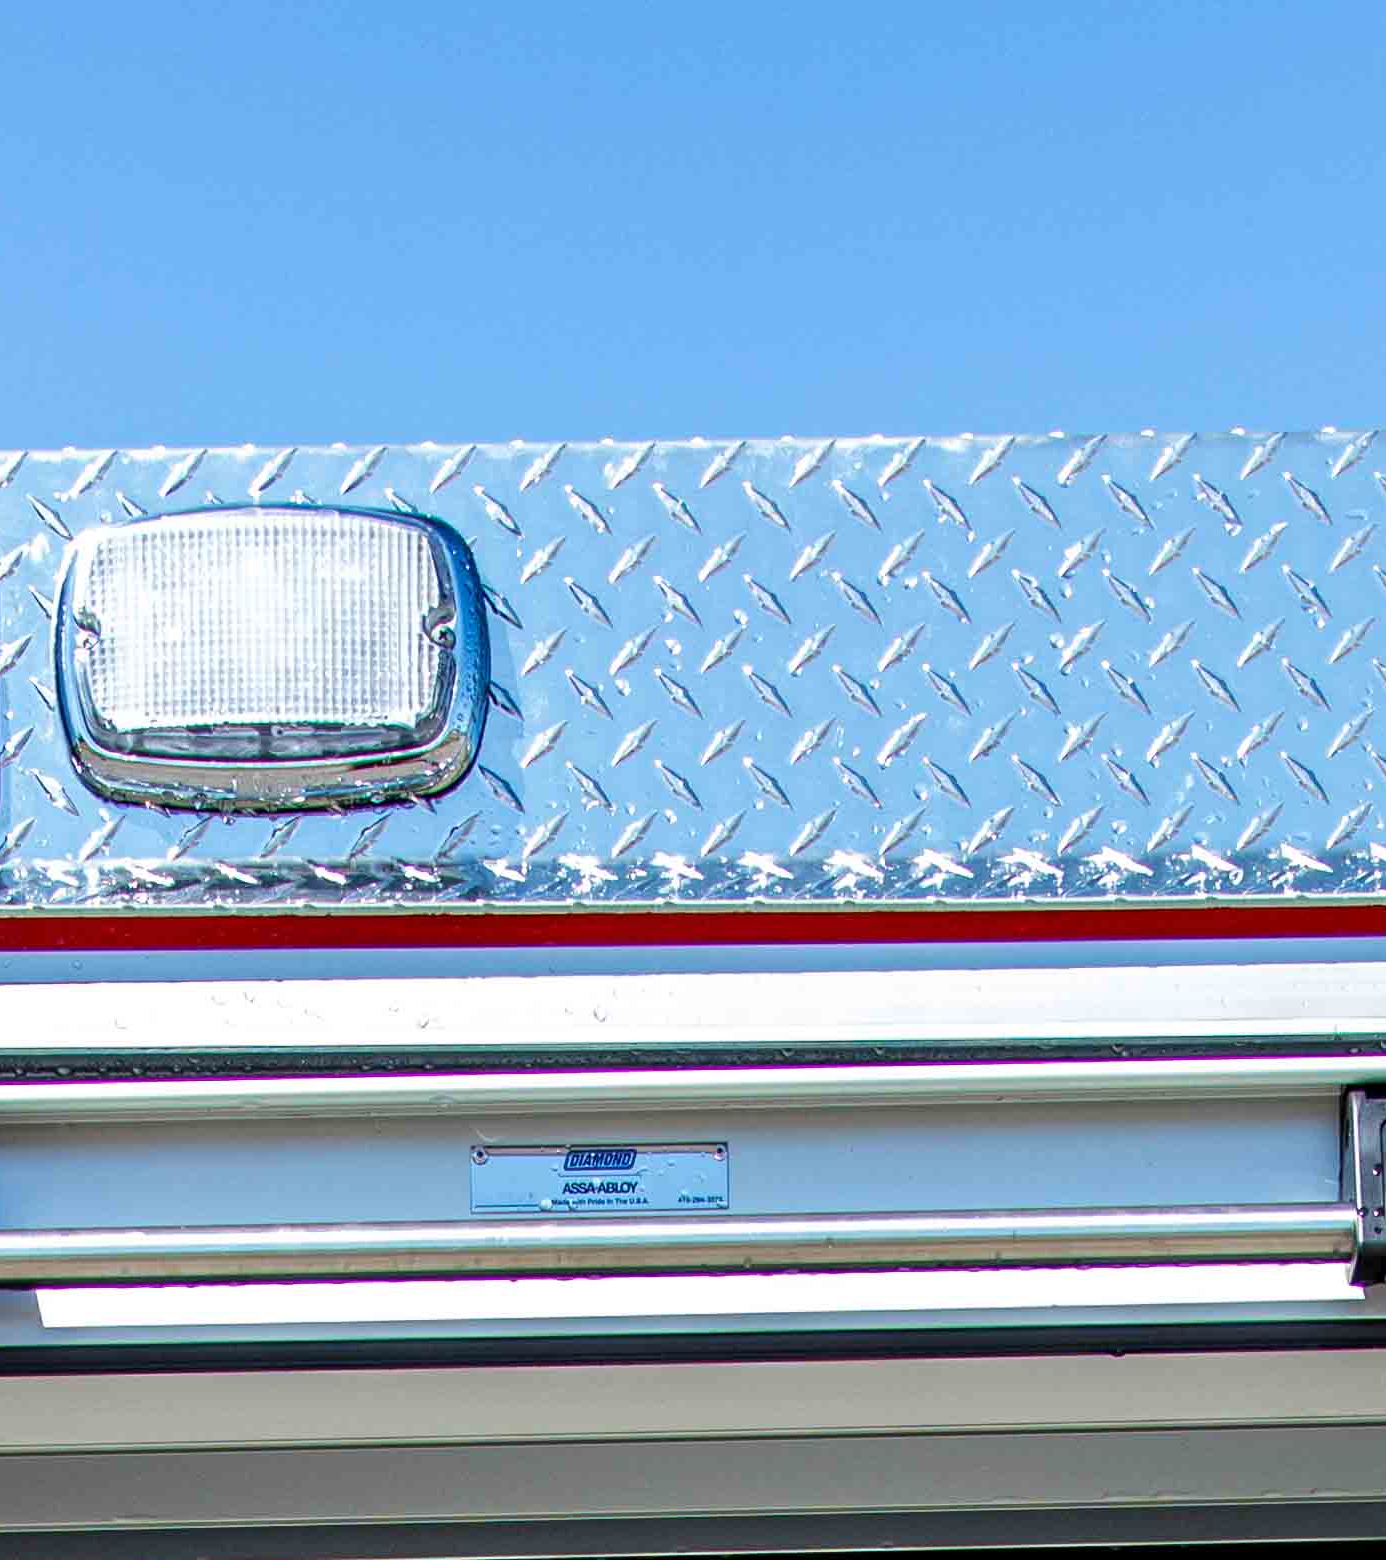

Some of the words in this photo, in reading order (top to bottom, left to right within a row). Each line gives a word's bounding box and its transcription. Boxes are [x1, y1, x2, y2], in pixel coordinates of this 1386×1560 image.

[568, 1151, 632, 1169] DIAMOND
[562, 1182, 595, 1195] ASSA
[597, 1181, 638, 1195] ABLOY
